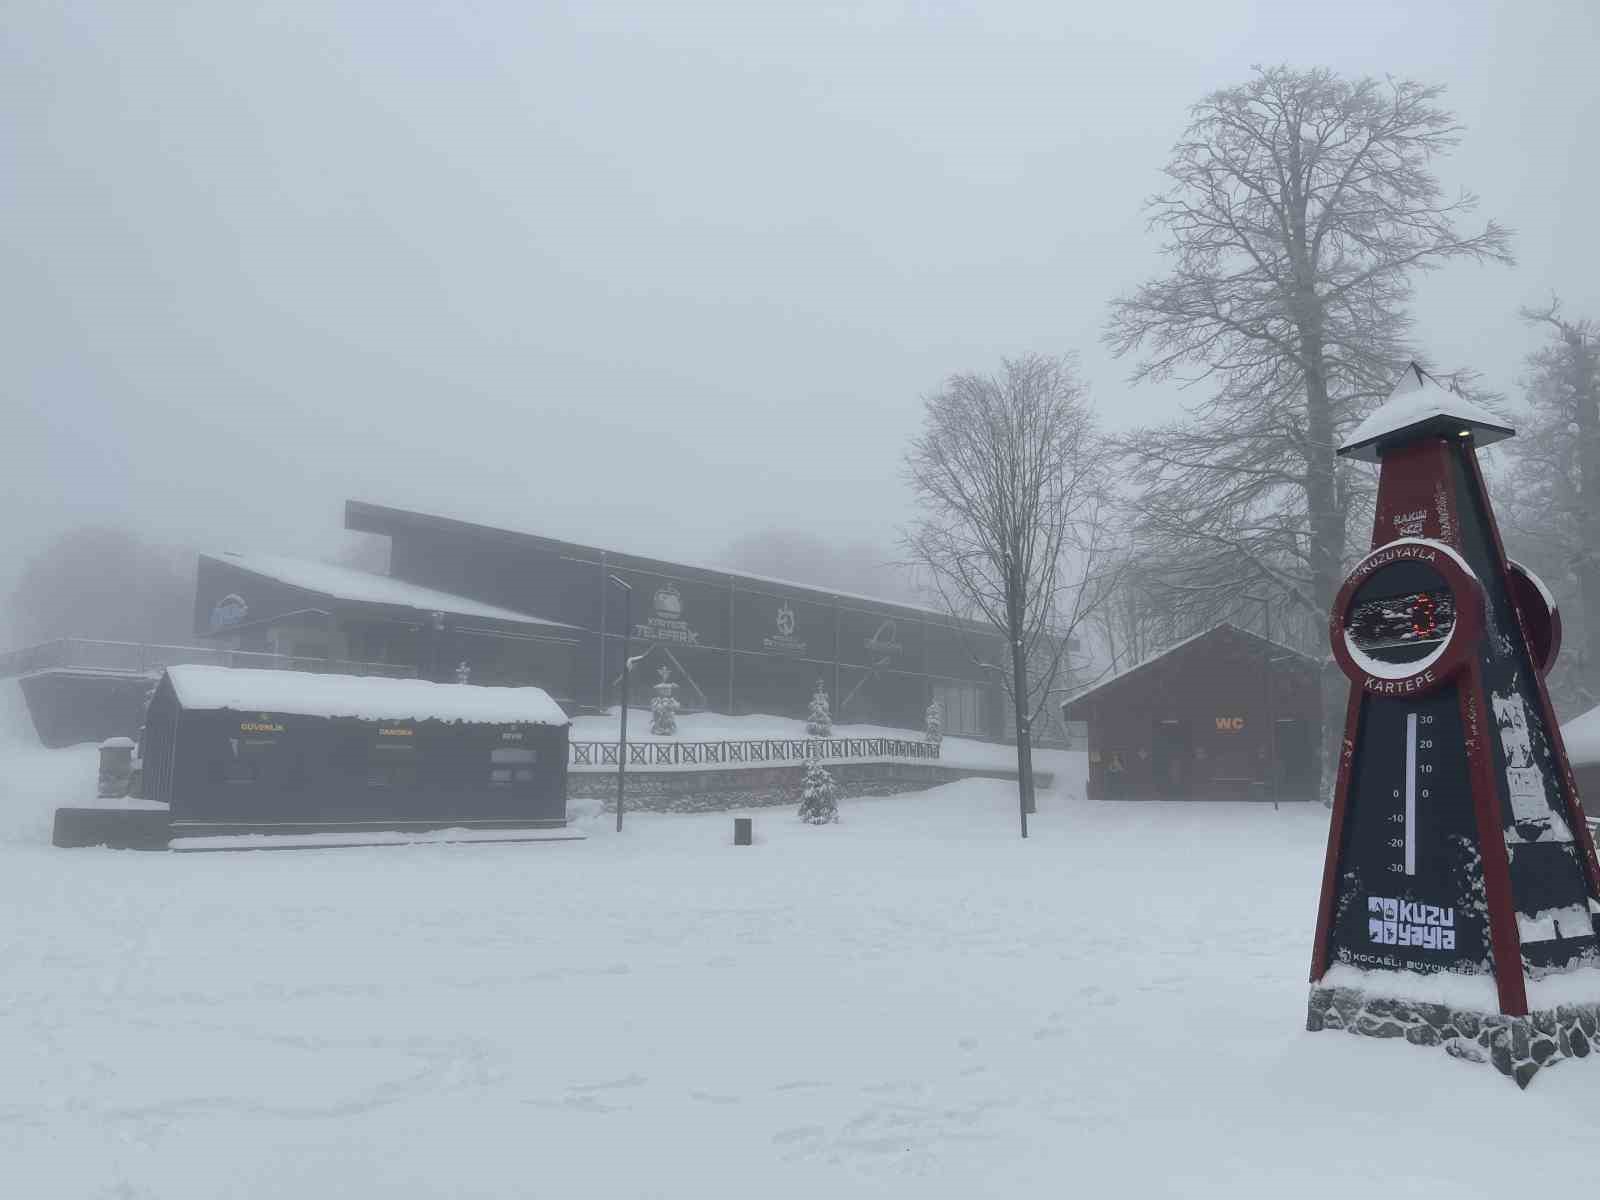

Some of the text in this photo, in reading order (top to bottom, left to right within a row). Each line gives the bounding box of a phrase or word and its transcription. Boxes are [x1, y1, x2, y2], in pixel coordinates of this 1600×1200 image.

[1362, 547, 1435, 575] KUZUYAYLA
[1364, 670, 1435, 693] KARTEPE
[1216, 717, 1244, 729] WC
[1420, 715, 1433, 724] 30
[1420, 740, 1433, 749] 20
[1420, 765, 1433, 774] 10
[1393, 790, 1400, 799] 0
[1422, 790, 1430, 798] 0
[1387, 814, 1404, 823] -10
[1387, 839, 1404, 848] -20
[1387, 864, 1404, 873] -30
